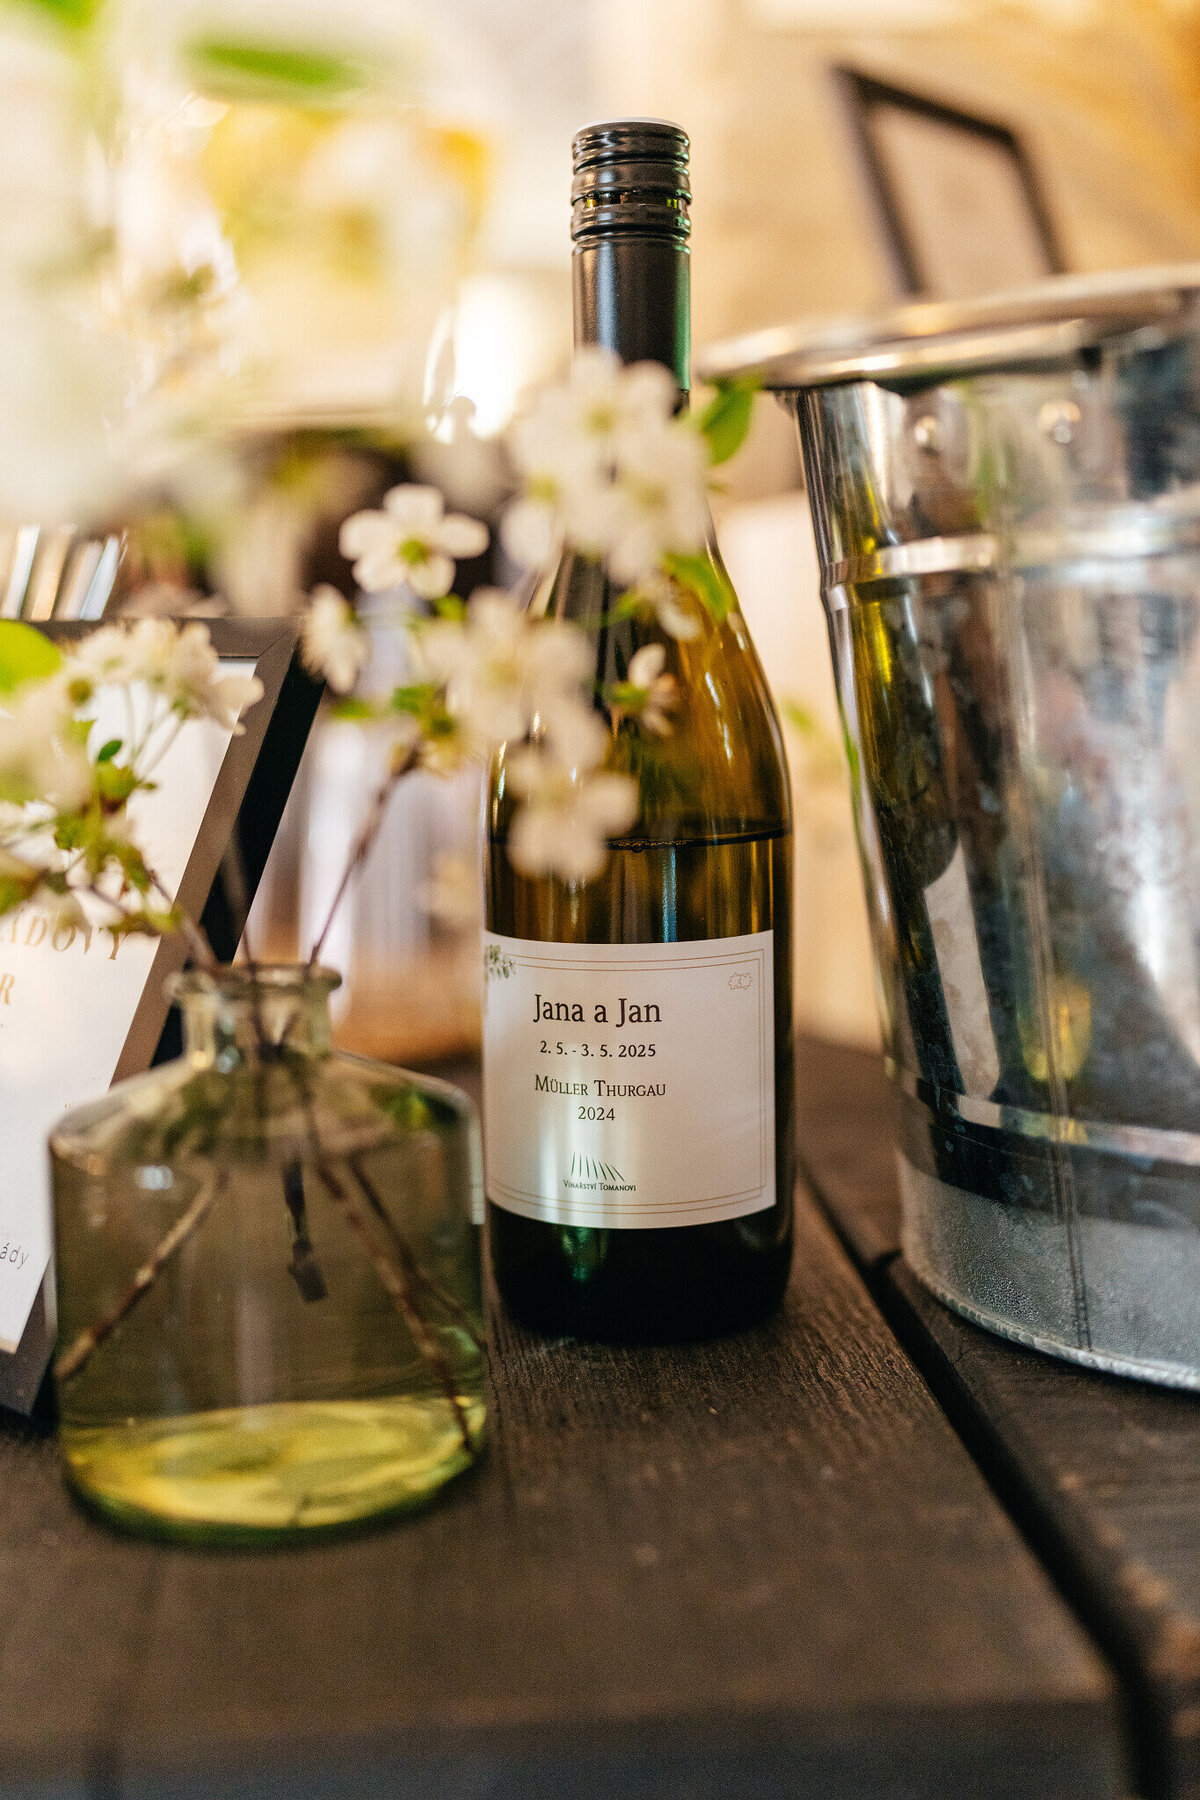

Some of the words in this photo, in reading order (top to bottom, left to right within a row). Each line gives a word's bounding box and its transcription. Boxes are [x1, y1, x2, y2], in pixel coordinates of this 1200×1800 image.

[533, 993, 586, 1023] Jana
[594, 1004, 609, 1023] a
[615, 998, 663, 1028] Jan
[618, 1043, 656, 1058] 2025
[534, 1074, 589, 1096] MÜLLER
[593, 1079, 666, 1097] THURGAU
[578, 1105, 616, 1121] 2024
[598, 1182, 637, 1192] TOMANOVI
